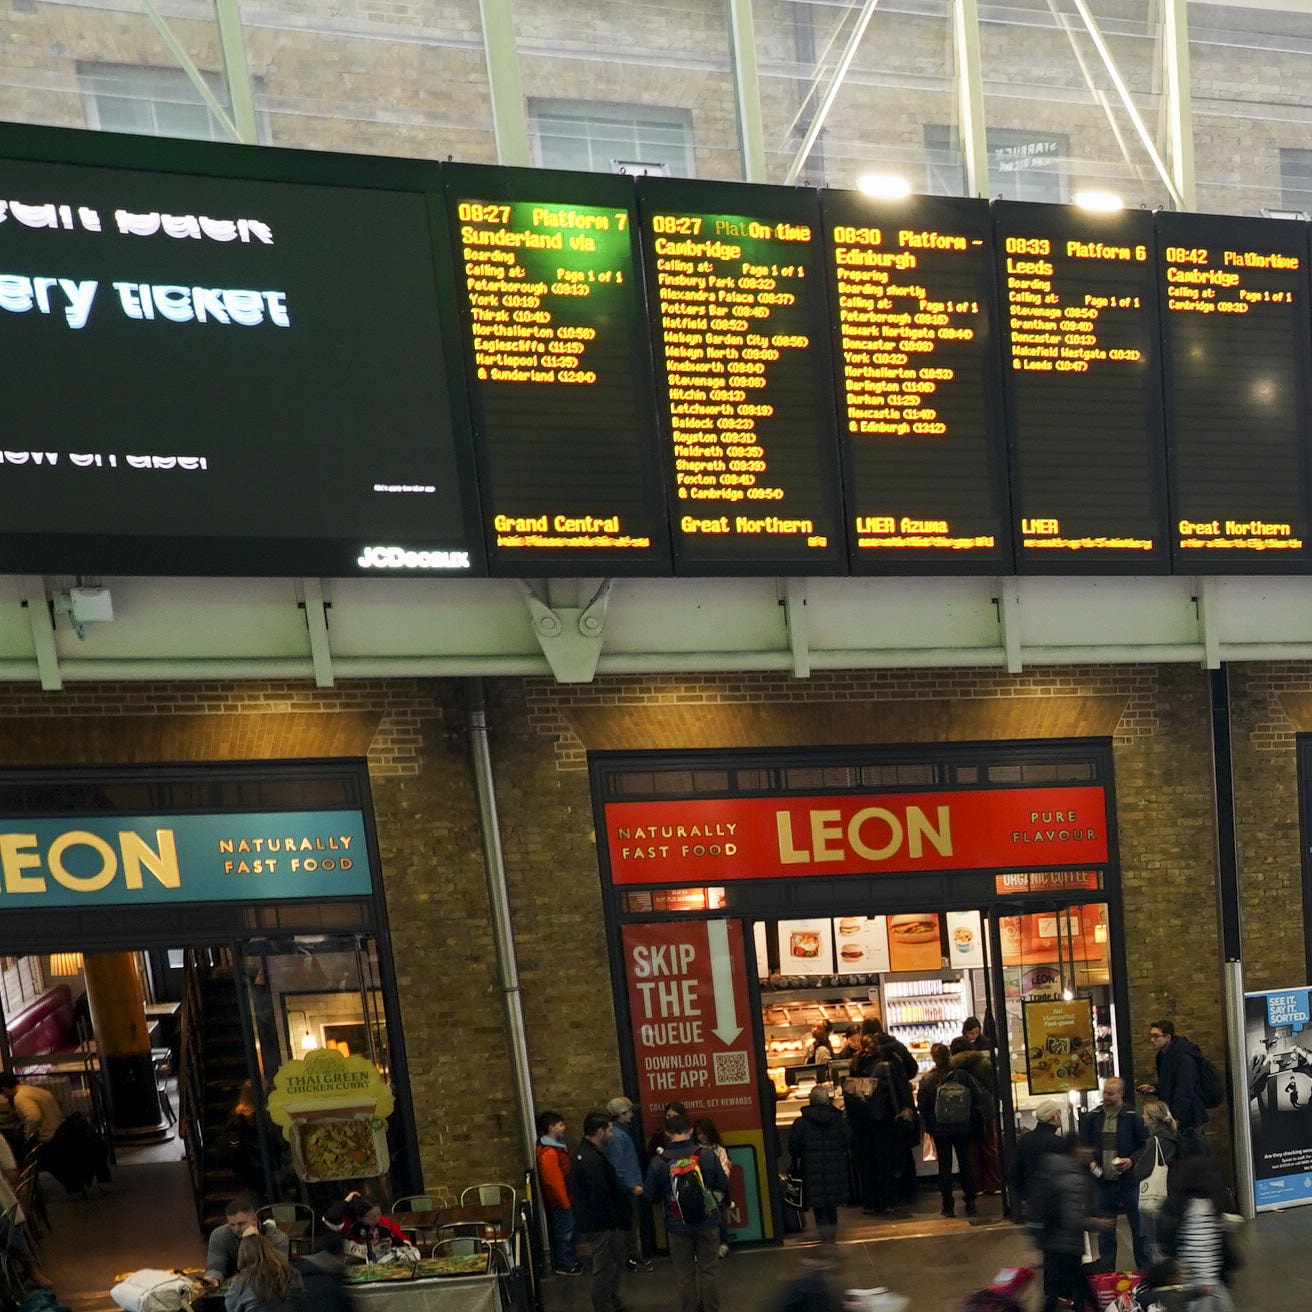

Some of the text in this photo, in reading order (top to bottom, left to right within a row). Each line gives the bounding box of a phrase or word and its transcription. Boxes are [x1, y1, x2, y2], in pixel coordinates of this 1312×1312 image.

[459, 203, 627, 230] 08:27 Platform 7
[653, 216, 702, 235] 08:27
[748, 222, 773, 239] On
[462, 226, 596, 252] Sunderland via
[834, 227, 967, 250] 08:30 Platform
[464, 248, 515, 265] Boarding
[655, 238, 741, 260] Cambridge
[1006, 238, 1146, 261] 08:33 Platform 6
[1167, 248, 1207, 264] 08:42
[836, 248, 916, 269] Edinburgh
[1007, 258, 1053, 276] Leeds
[1167, 268, 1239, 287] Cambridge
[467, 278, 548, 295] Peterborough
[473, 323, 554, 338] Northallerton
[476, 353, 537, 368] Hartlepool
[495, 515, 619, 532] Grand Central
[682, 516, 813, 534] Great Northern
[857, 517, 949, 534] LNER Azuma
[358, 547, 470, 568] JCDecaux
[1031, 810, 1076, 823] PURE
[618, 823, 737, 841] NATURALLY
[776, 805, 953, 864] LEON
[1012, 828, 1097, 844] FLAVOUR
[218, 836, 353, 853] NATURALLY
[622, 843, 737, 860] FAST FOOD
[224, 858, 354, 874] FAST FOOD
[633, 944, 695, 977] SKIP
[636, 980, 701, 1018] THE
[1269, 996, 1297, 1006] SEE IT.
[1270, 1005, 1297, 1015] SAY IT.
[1270, 1012, 1308, 1024] SORTED.
[641, 1021, 704, 1047] QUEUE
[645, 1053, 707, 1070] DOWNLOAD
[286, 1072, 369, 1087] THAI GREEN
[287, 1081, 371, 1094] CHICKEN CURRY
[647, 1070, 711, 1090] THE APP.
[708, 1097, 752, 1108] GET REWARDS
